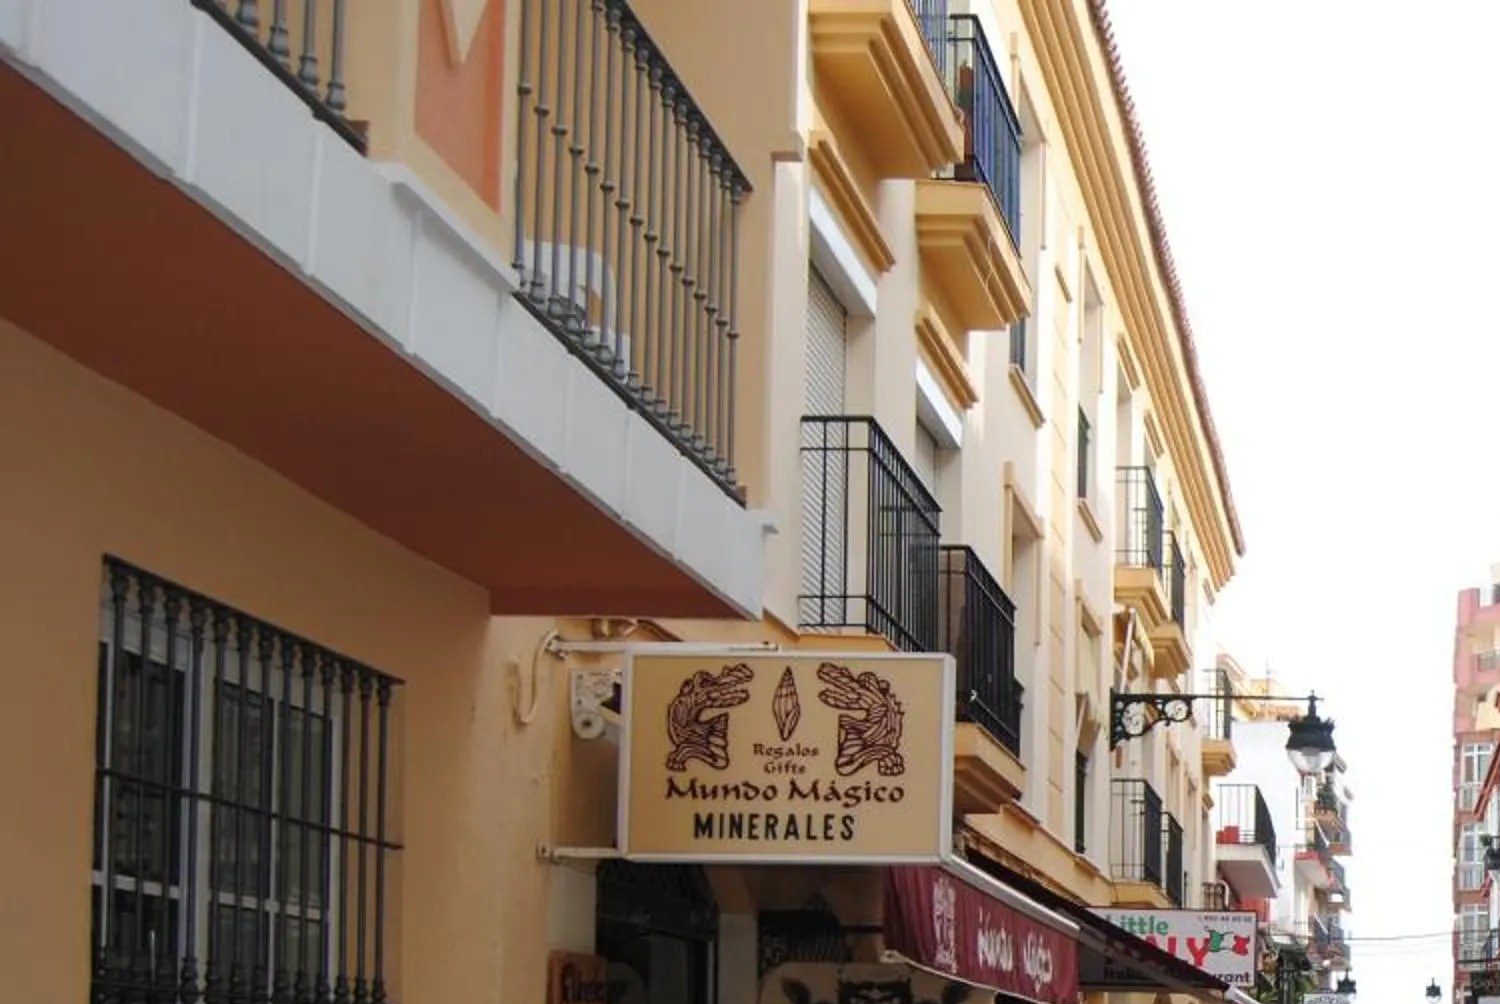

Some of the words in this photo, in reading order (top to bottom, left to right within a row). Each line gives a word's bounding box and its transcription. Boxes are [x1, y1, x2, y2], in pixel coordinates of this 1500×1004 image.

[753, 743, 820, 757] Regalos
[665, 776, 778, 801] Mundo
[788, 778, 905, 808] Mágico
[693, 812, 856, 841] MINERALES
